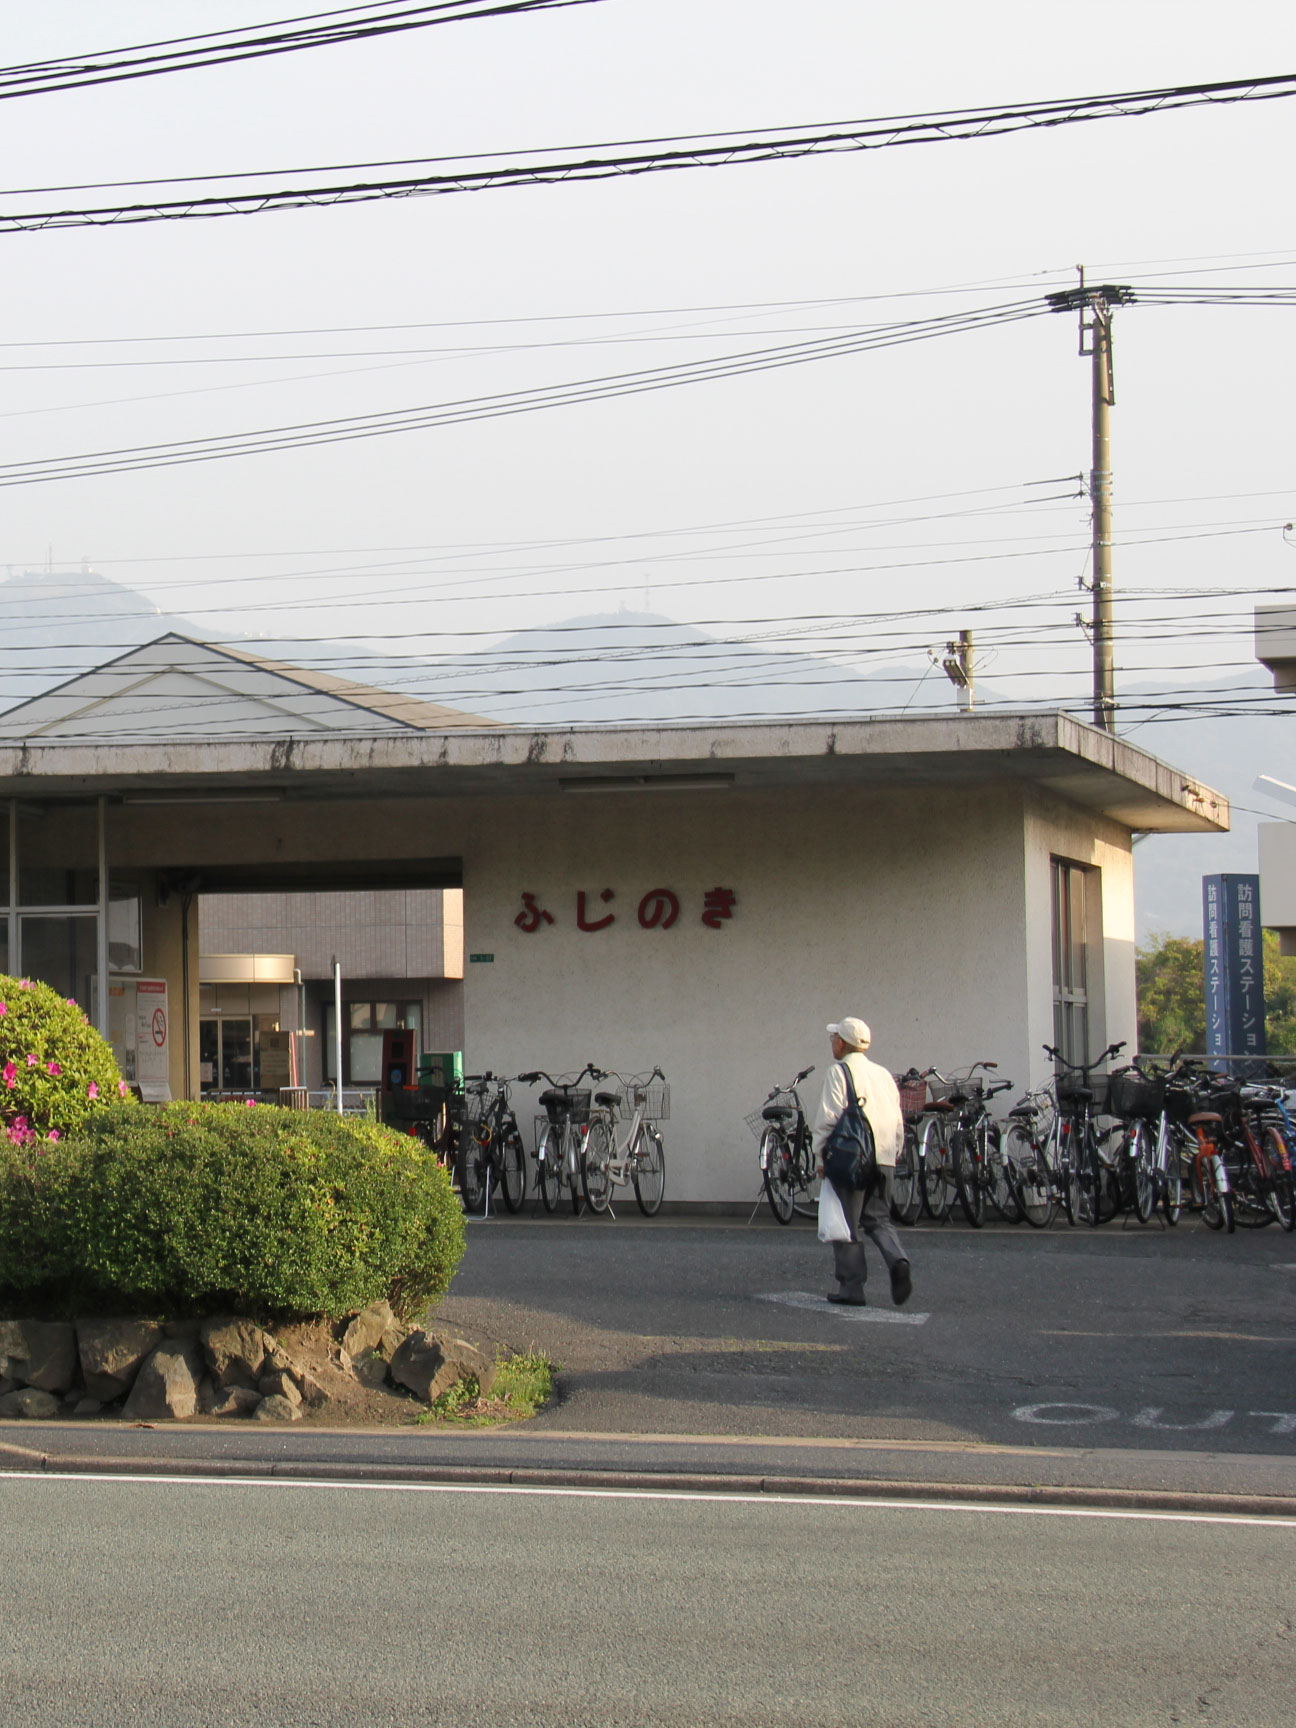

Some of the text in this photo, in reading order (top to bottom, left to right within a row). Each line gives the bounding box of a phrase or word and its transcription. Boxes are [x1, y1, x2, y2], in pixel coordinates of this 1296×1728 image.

[514, 887, 737, 933] ふじのき
[1207, 884, 1222, 1066] 訪問看護ステーション
[1237, 884, 1256, 1066] 訪問看護ステーション
